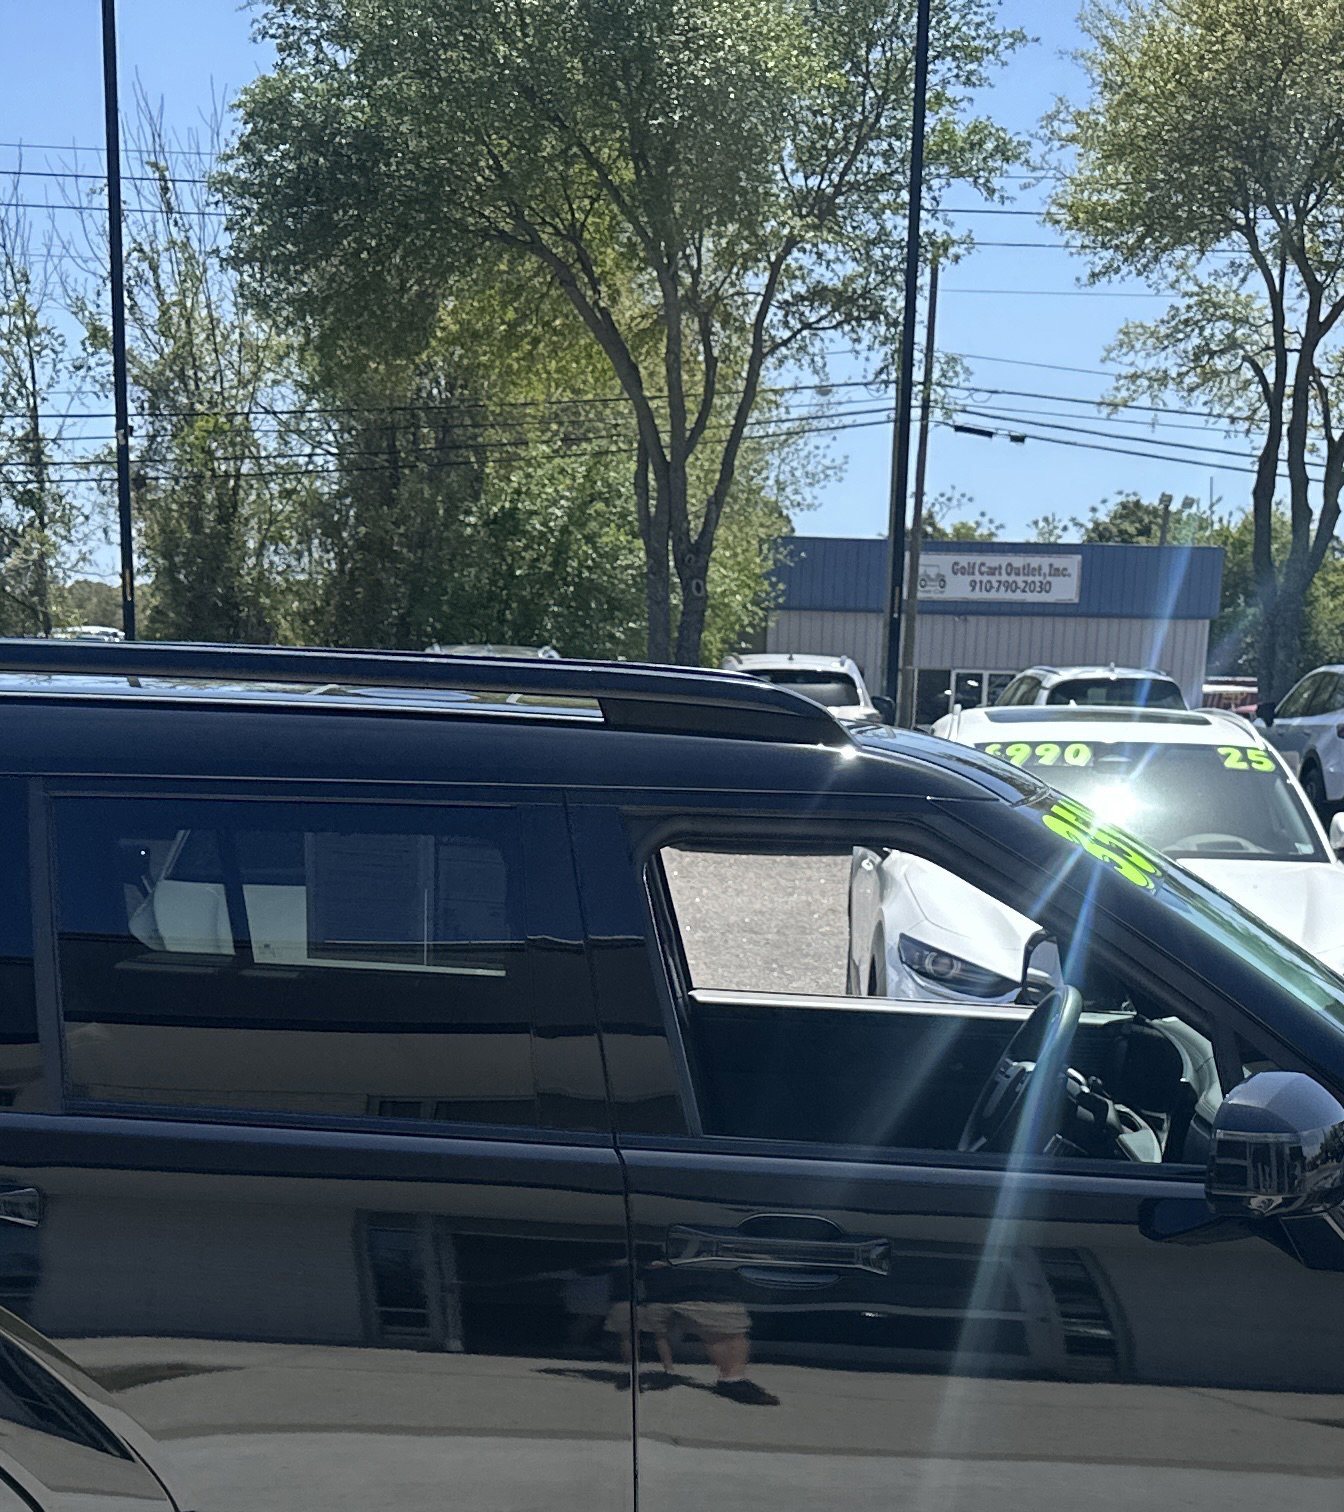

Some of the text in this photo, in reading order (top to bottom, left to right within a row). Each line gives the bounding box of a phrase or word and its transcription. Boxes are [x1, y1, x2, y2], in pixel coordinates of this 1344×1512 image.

[952, 561, 1072, 580] Golf Cart Outlet, Inc.
[969, 580, 1052, 593] 910-790-2030
[1217, 747, 1276, 772] 25
